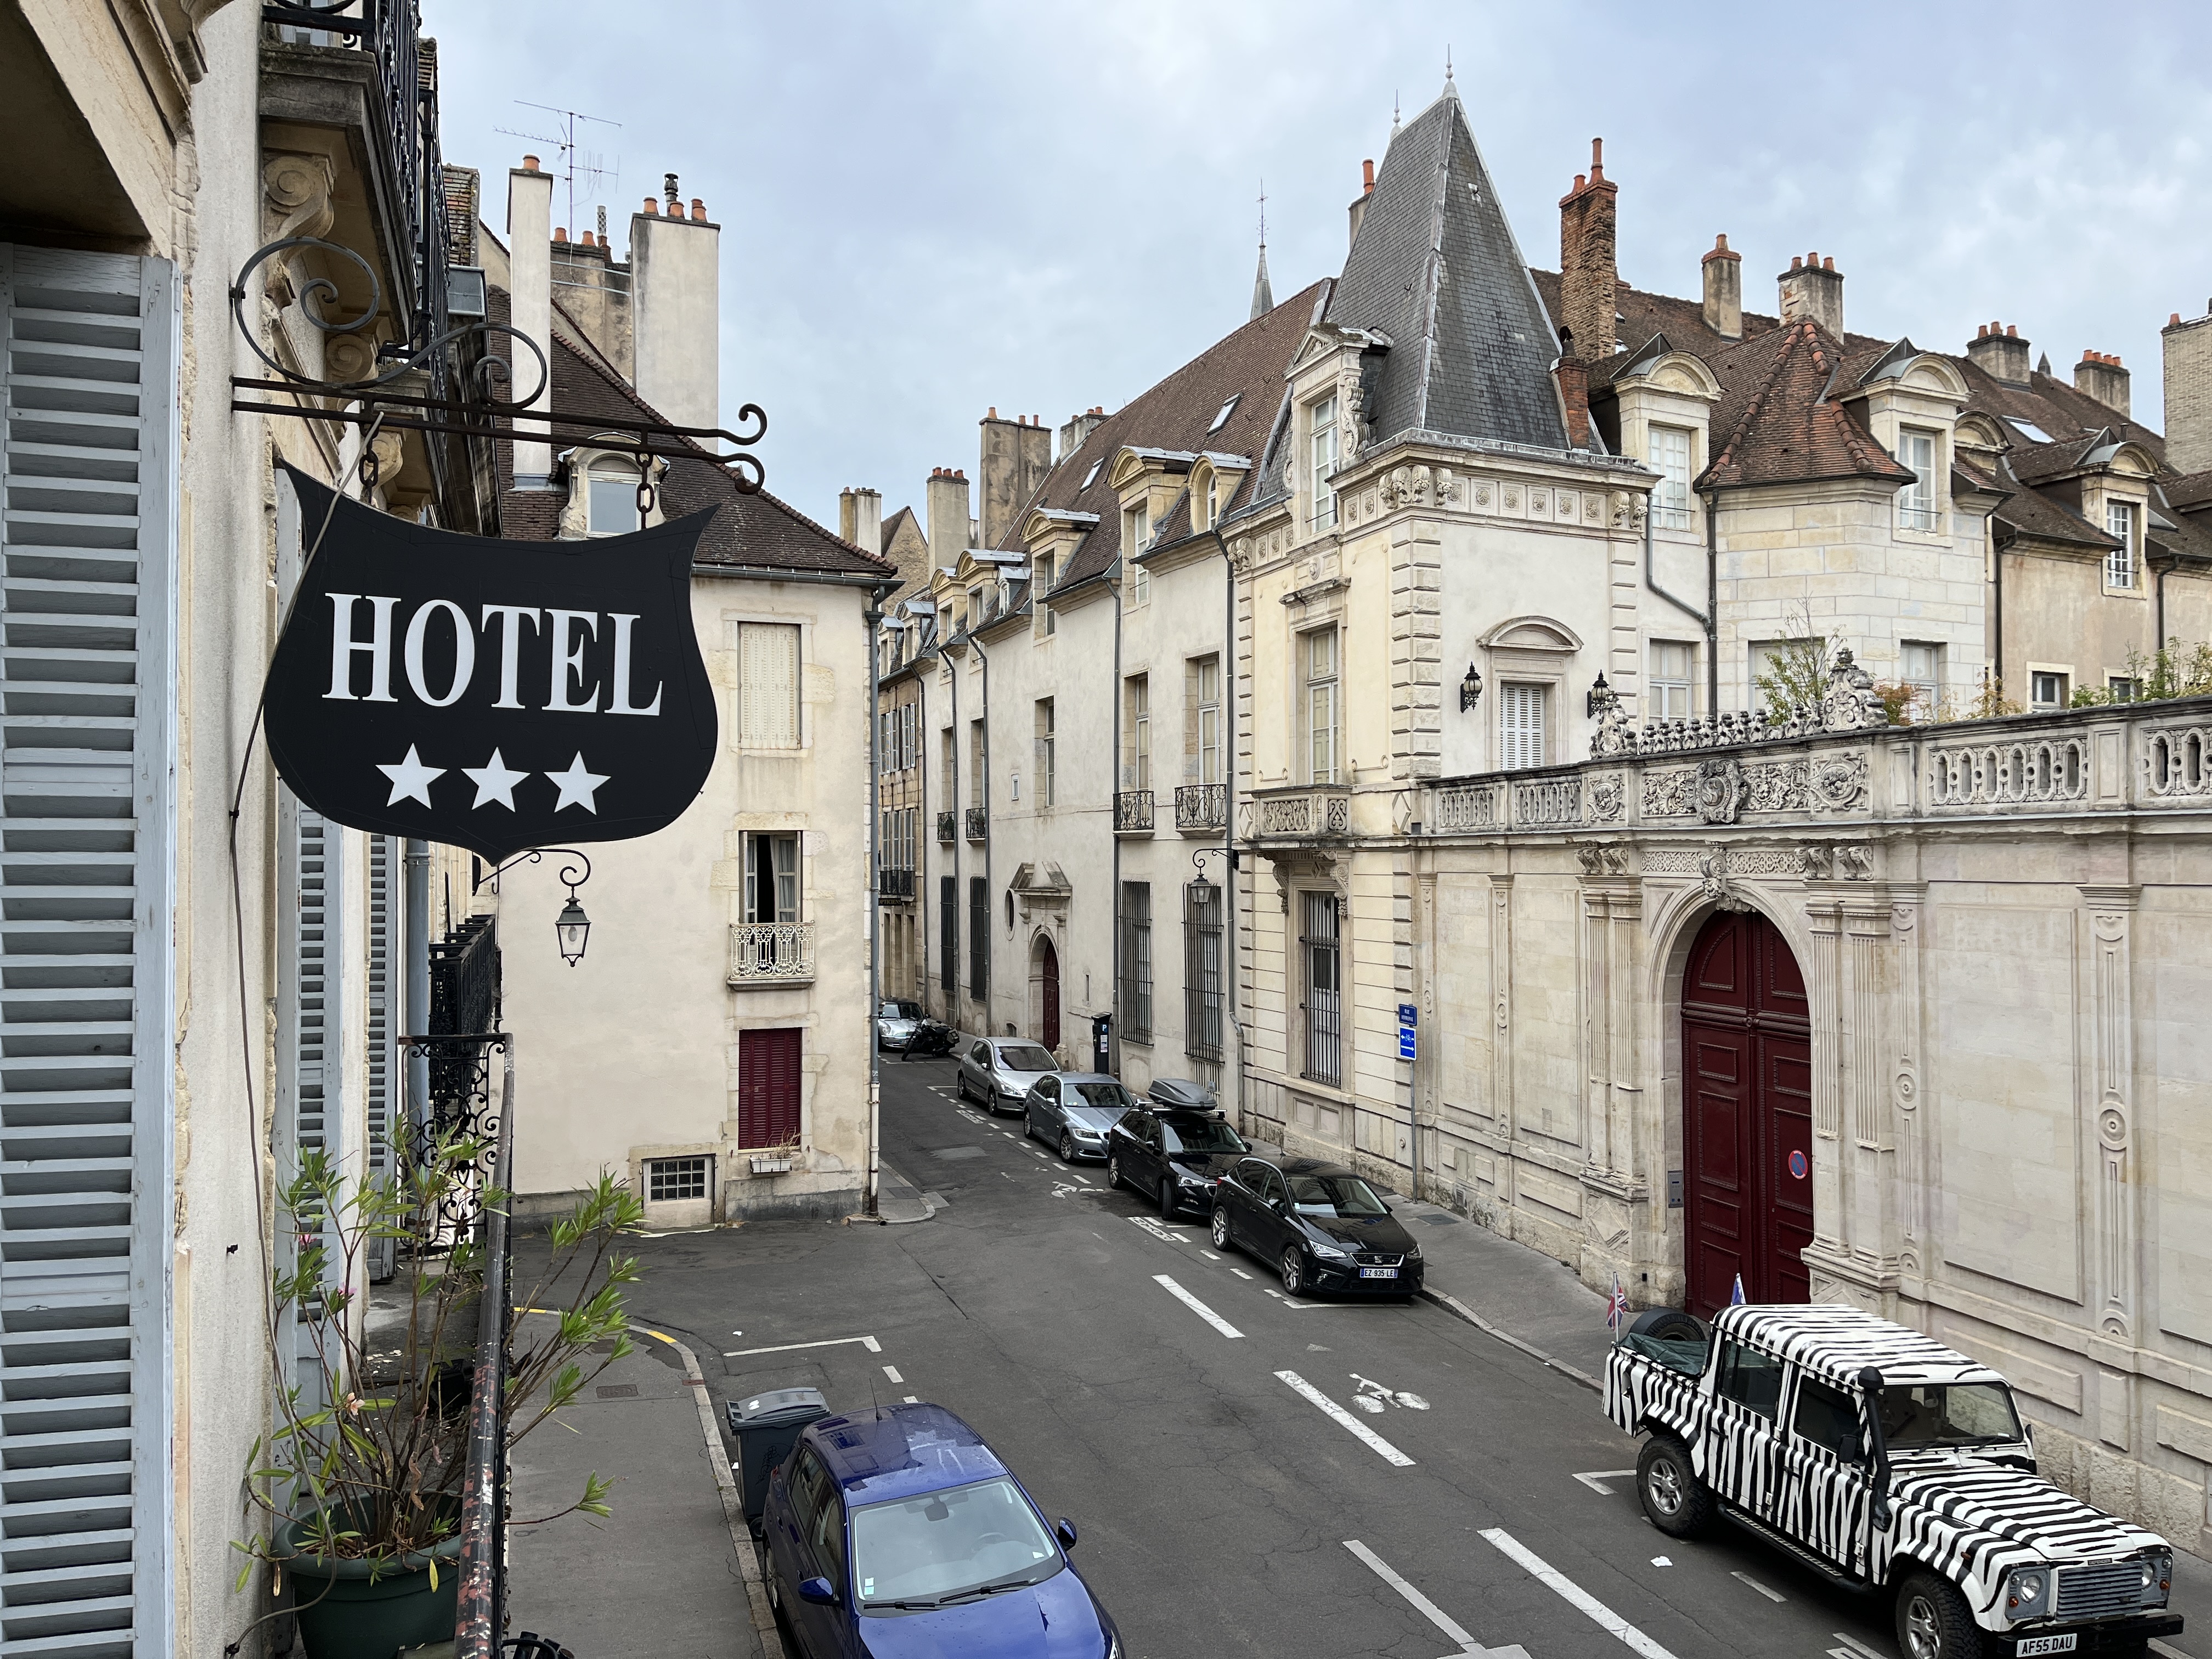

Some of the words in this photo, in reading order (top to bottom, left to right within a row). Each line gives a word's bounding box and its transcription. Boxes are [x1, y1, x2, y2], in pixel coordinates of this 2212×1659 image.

[322, 592, 663, 716] HOTEL
[2022, 1639, 2050, 1655] AF55
[2051, 1636, 2073, 1651] DAU
